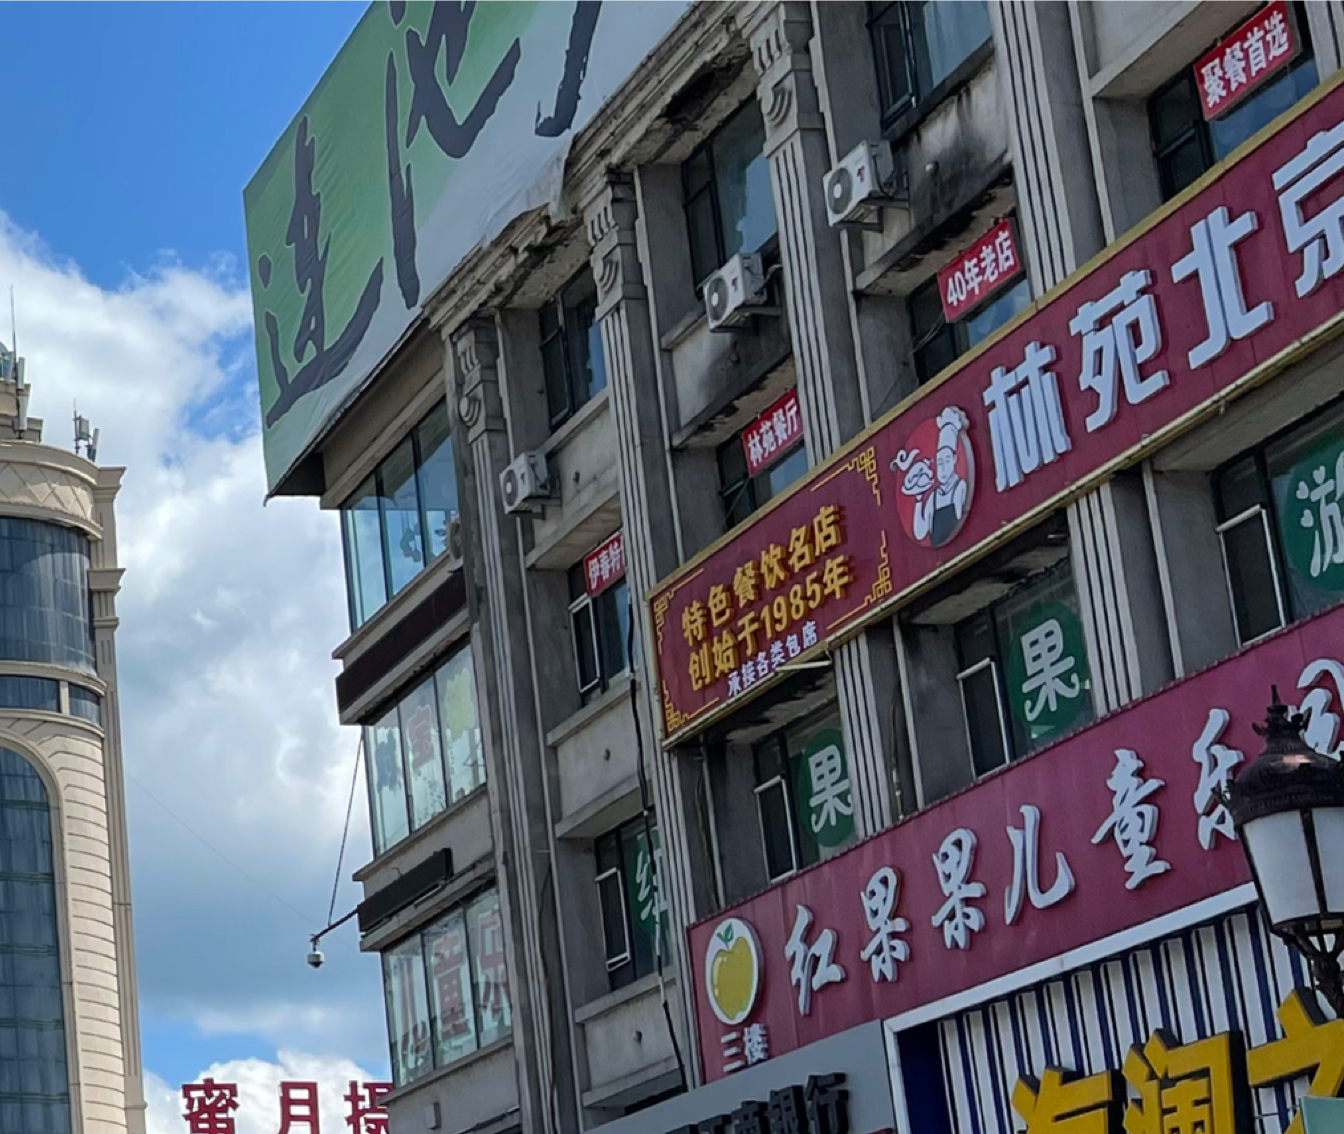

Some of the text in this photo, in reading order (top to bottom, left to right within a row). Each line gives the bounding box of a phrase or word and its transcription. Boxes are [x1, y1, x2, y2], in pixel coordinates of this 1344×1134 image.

[1200, 10, 1291, 108] 聚餐首选
[945, 230, 1016, 308] 40年老店
[983, 118, 1344, 493] 林苑北京
[747, 396, 801, 466] 林苑餐厅
[682, 504, 841, 647] 特色餐饮名店
[688, 555, 850, 691] 创始于1985年
[727, 620, 819, 697] 承接各类包席
[1020, 619, 1088, 722] 果
[721, 1022, 769, 1073] 三楼
